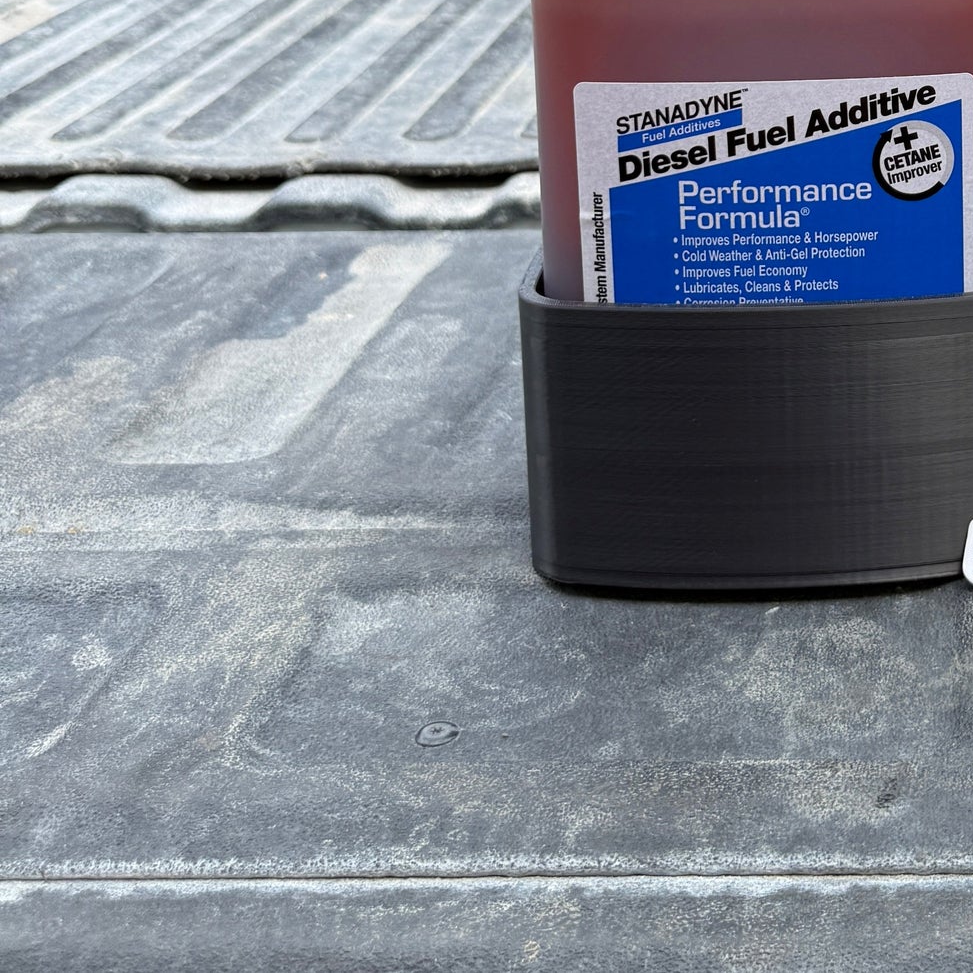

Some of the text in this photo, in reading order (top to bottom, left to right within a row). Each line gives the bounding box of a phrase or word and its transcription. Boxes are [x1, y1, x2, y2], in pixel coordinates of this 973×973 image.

[618, 85, 936, 183] Diesel Fuel Additive
[642, 119, 721, 143] Fuel Additives
[884, 144, 941, 172] CETANE
[887, 160, 943, 185] Improver
[678, 180, 873, 205] Performance
[592, 192, 606, 272] Manufacturer
[681, 231, 879, 248] Improves Performance & Horsepower
[682, 246, 866, 262] Cold Weather & Anti-Gel Protection
[682, 264, 808, 280] Improves Fuel Economy
[683, 279, 839, 294] Lubricates, Cleans & Protects
